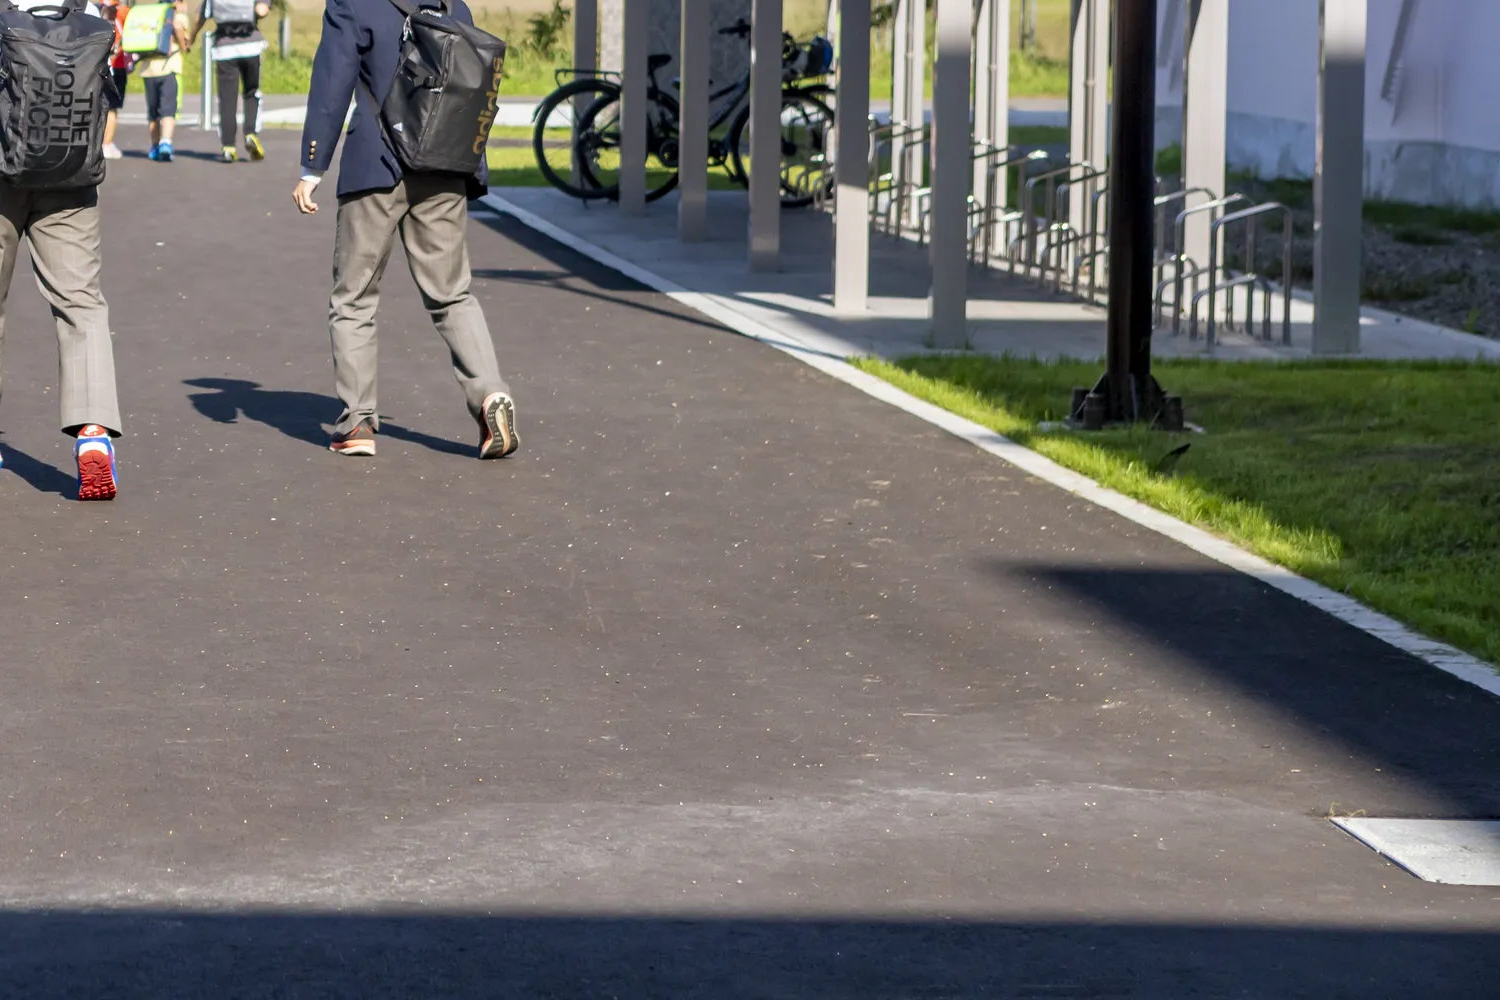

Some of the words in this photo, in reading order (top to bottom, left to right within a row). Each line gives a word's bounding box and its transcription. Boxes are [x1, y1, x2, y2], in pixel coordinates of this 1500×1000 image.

[27, 76, 53, 142] FACE
[49, 53, 75, 143] NORTH
[71, 92, 94, 142] THE
[473, 57, 504, 155] adidas
